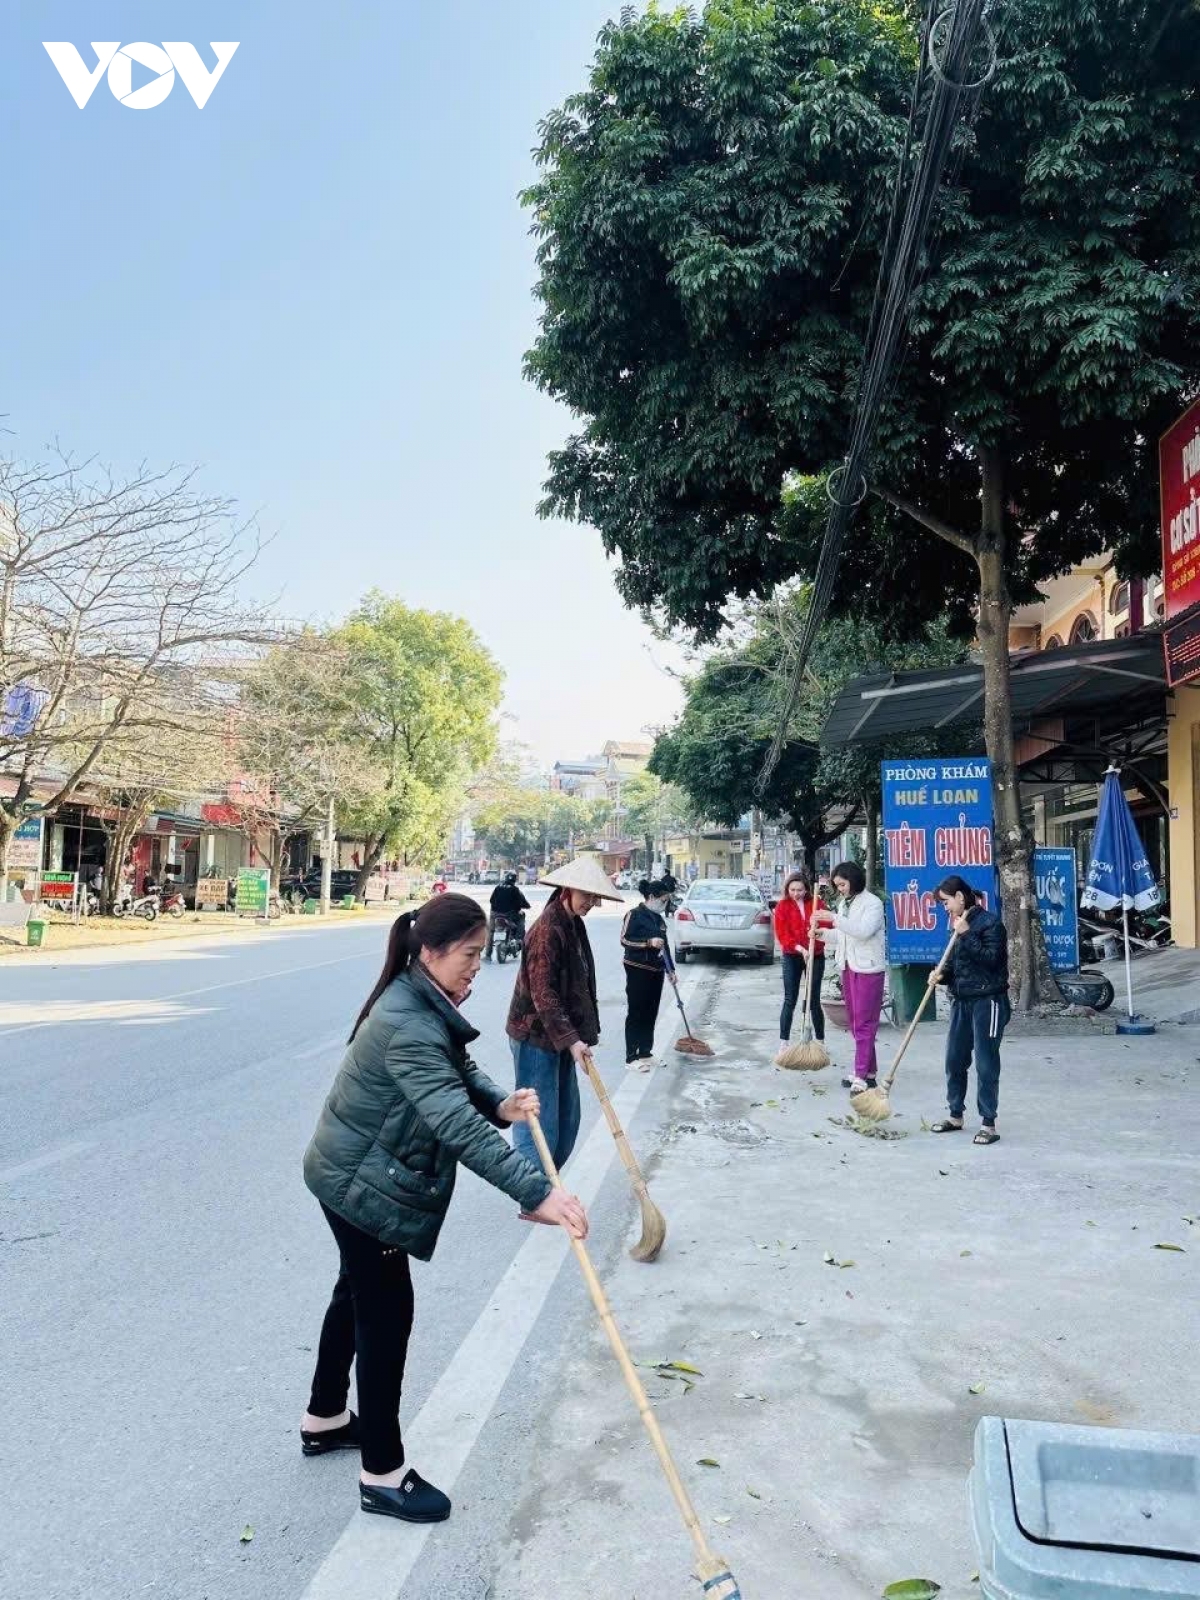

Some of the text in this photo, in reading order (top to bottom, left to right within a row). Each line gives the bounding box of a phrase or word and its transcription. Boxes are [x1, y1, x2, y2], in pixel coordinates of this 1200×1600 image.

[885, 762, 988, 781] PHÒNG KHÁM
[895, 785, 979, 806] HUẾ LOAN
[885, 820, 927, 867] TIÊM
[892, 879, 937, 931] VẮC
